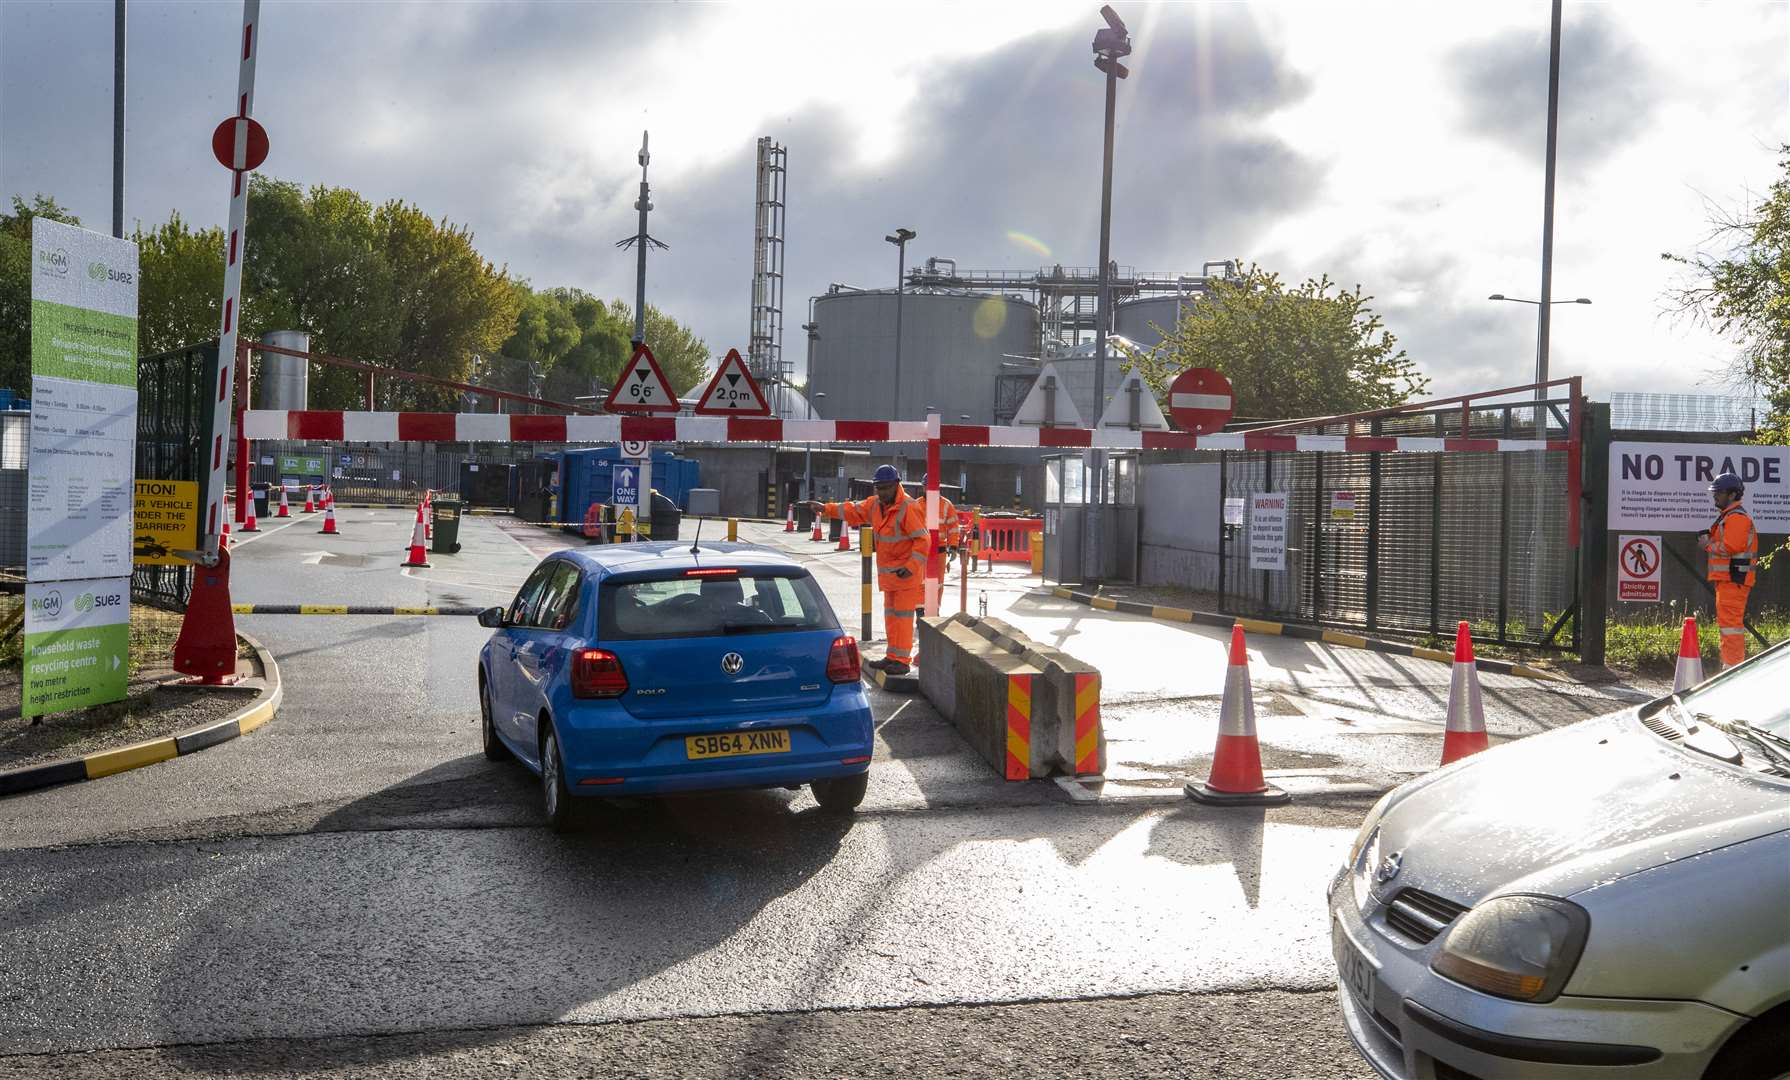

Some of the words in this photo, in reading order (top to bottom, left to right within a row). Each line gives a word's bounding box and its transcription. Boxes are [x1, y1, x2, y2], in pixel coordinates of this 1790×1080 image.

[630, 441, 640, 450] 5
[1622, 454, 1664, 480] NO
[1674, 455, 1780, 484] TRADE
[135, 484, 176, 496] TION!
[150, 500, 192, 510] VEHICLE
[1255, 499, 1284, 509] WARNING
[134, 511, 161, 519] NDER
[167, 512, 185, 520] THE
[136, 522, 186, 531] BARRIER?
[32, 597, 59, 610] R4GM
[95, 595, 120, 607] suez
[32, 640, 74, 656] household
[79, 638, 101, 650] waste
[32, 659, 68, 675] recycling
[71, 656, 97, 666] centre
[30, 681, 44, 689] two
[46, 676, 67, 686] metre
[30, 692, 52, 704] height
[54, 686, 90, 700] restriction
[695, 735, 742, 754] SB64
[748, 732, 783, 750] XNN
